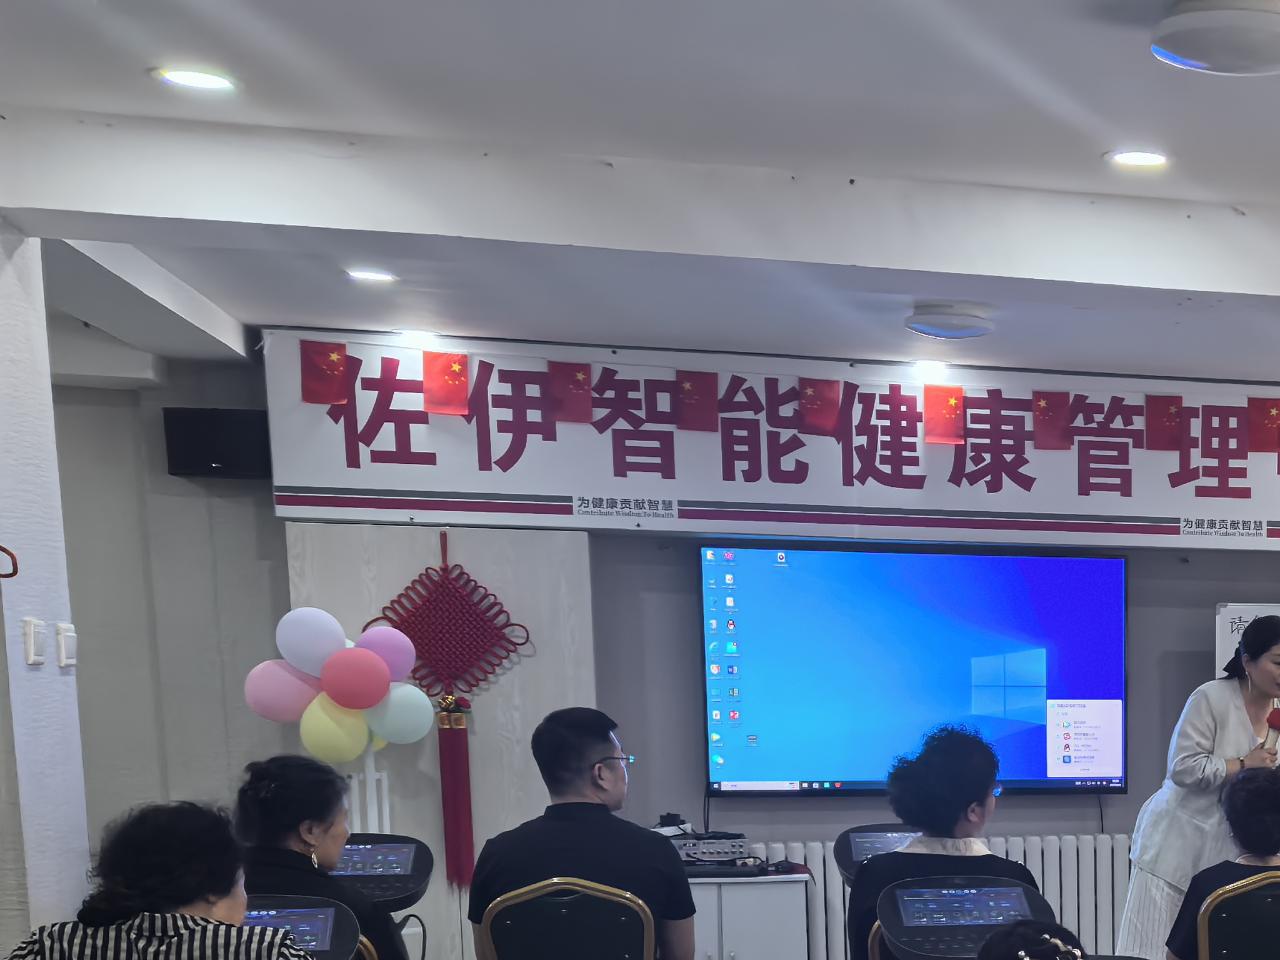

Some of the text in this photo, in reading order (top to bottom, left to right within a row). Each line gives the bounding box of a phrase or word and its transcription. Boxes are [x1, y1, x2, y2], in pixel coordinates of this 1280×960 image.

[577, 496, 674, 511] 为健康贡献智慧
[1183, 518, 1263, 531] 为健康贡献智慧
